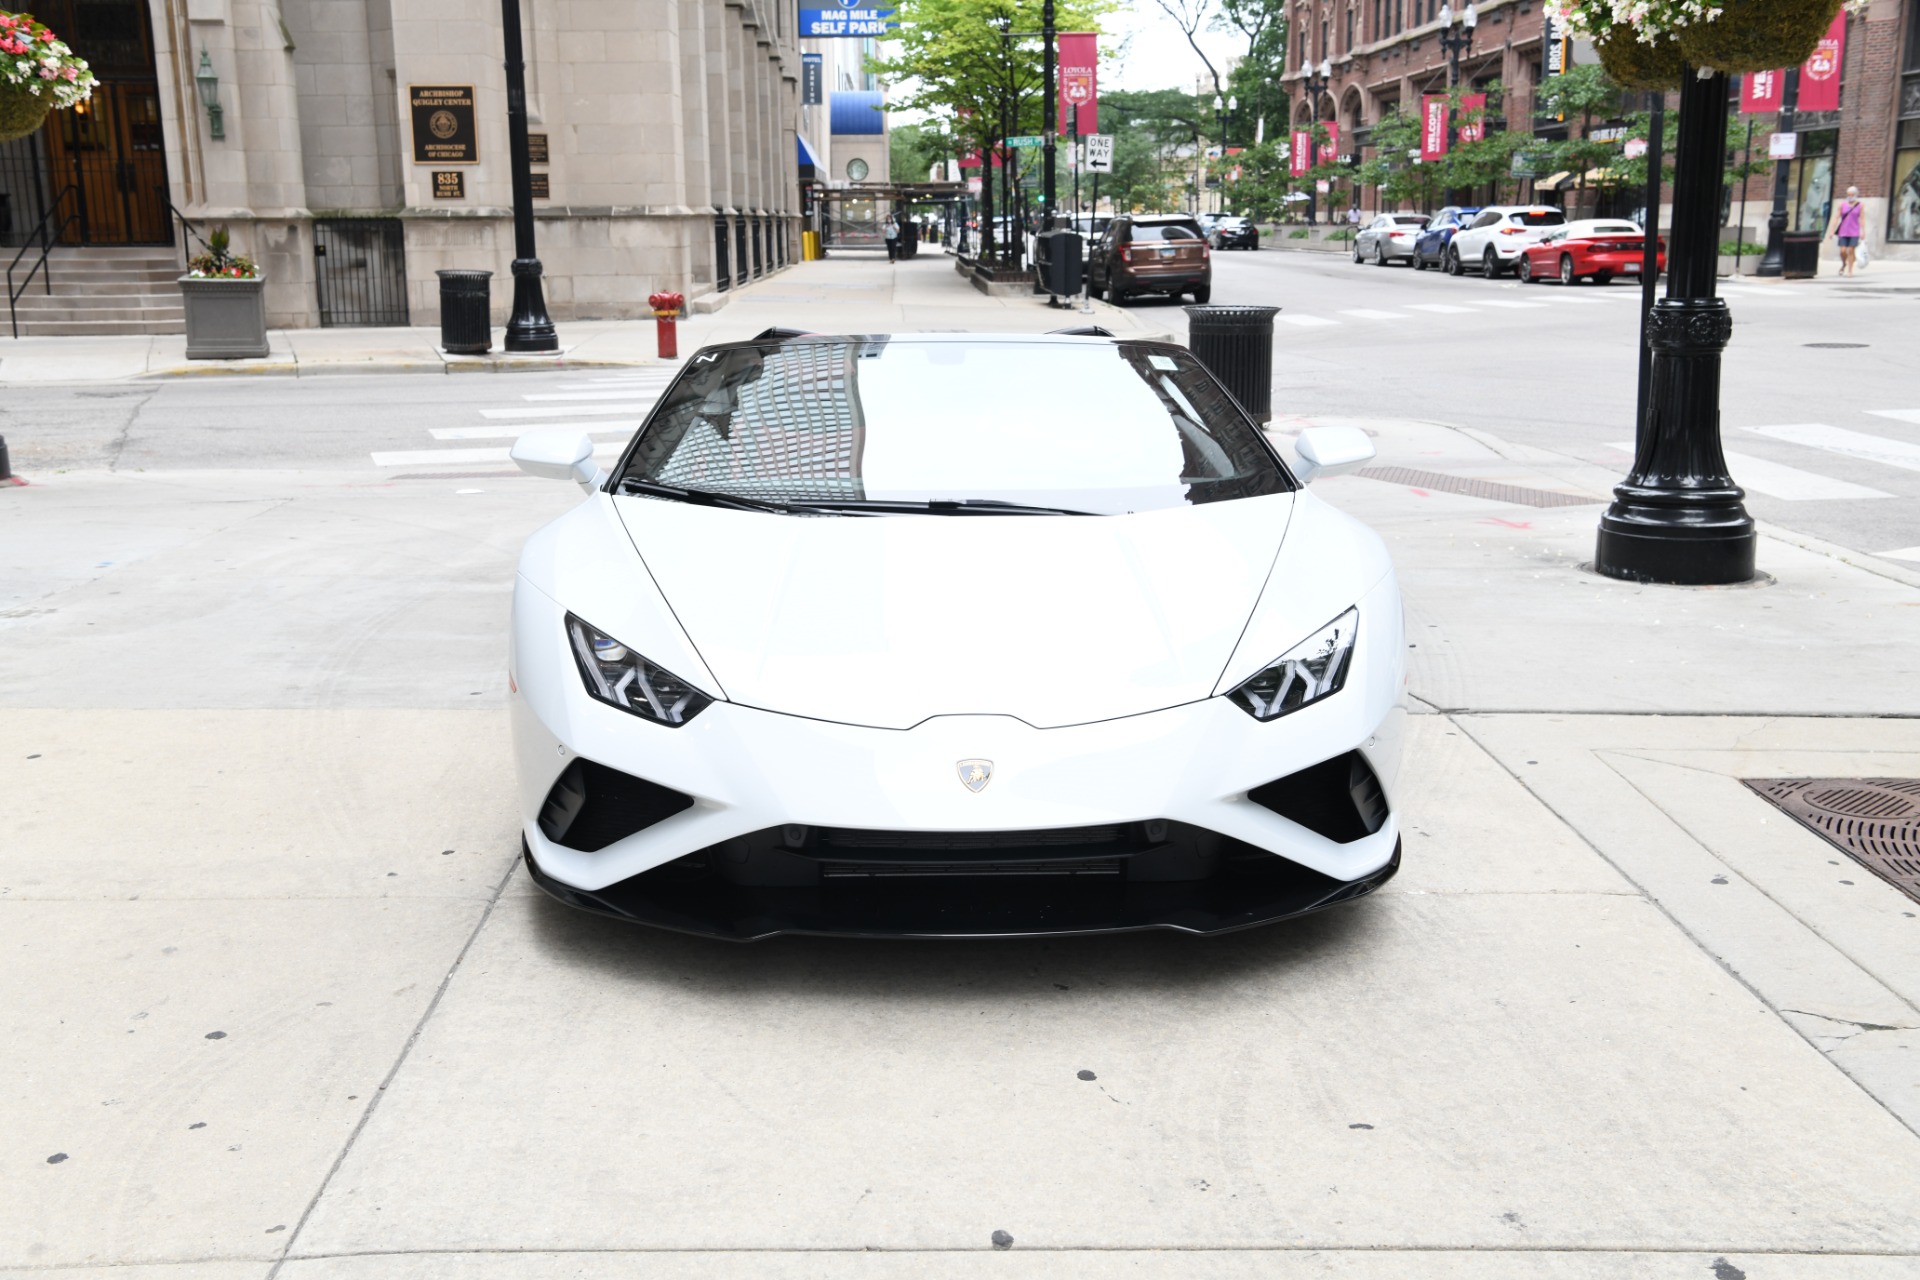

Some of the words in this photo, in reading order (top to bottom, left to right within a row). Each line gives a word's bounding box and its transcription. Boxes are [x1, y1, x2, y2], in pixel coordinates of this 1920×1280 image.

[821, 10, 847, 20] MAG
[850, 10, 878, 20] MILE
[811, 22, 846, 34] SELF
[849, 22, 887, 34] PARK
[419, 90, 464, 98] ARCHBISHOP
[412, 98, 443, 106] QUIGLEY
[444, 98, 472, 106] CENTER
[1427, 103, 1437, 152] WELCOME
[1013, 136, 1033, 146] RUSH
[1090, 138, 1110, 147] ONE
[1089, 149, 1110, 157] WAY
[437, 173, 458, 184] 835
